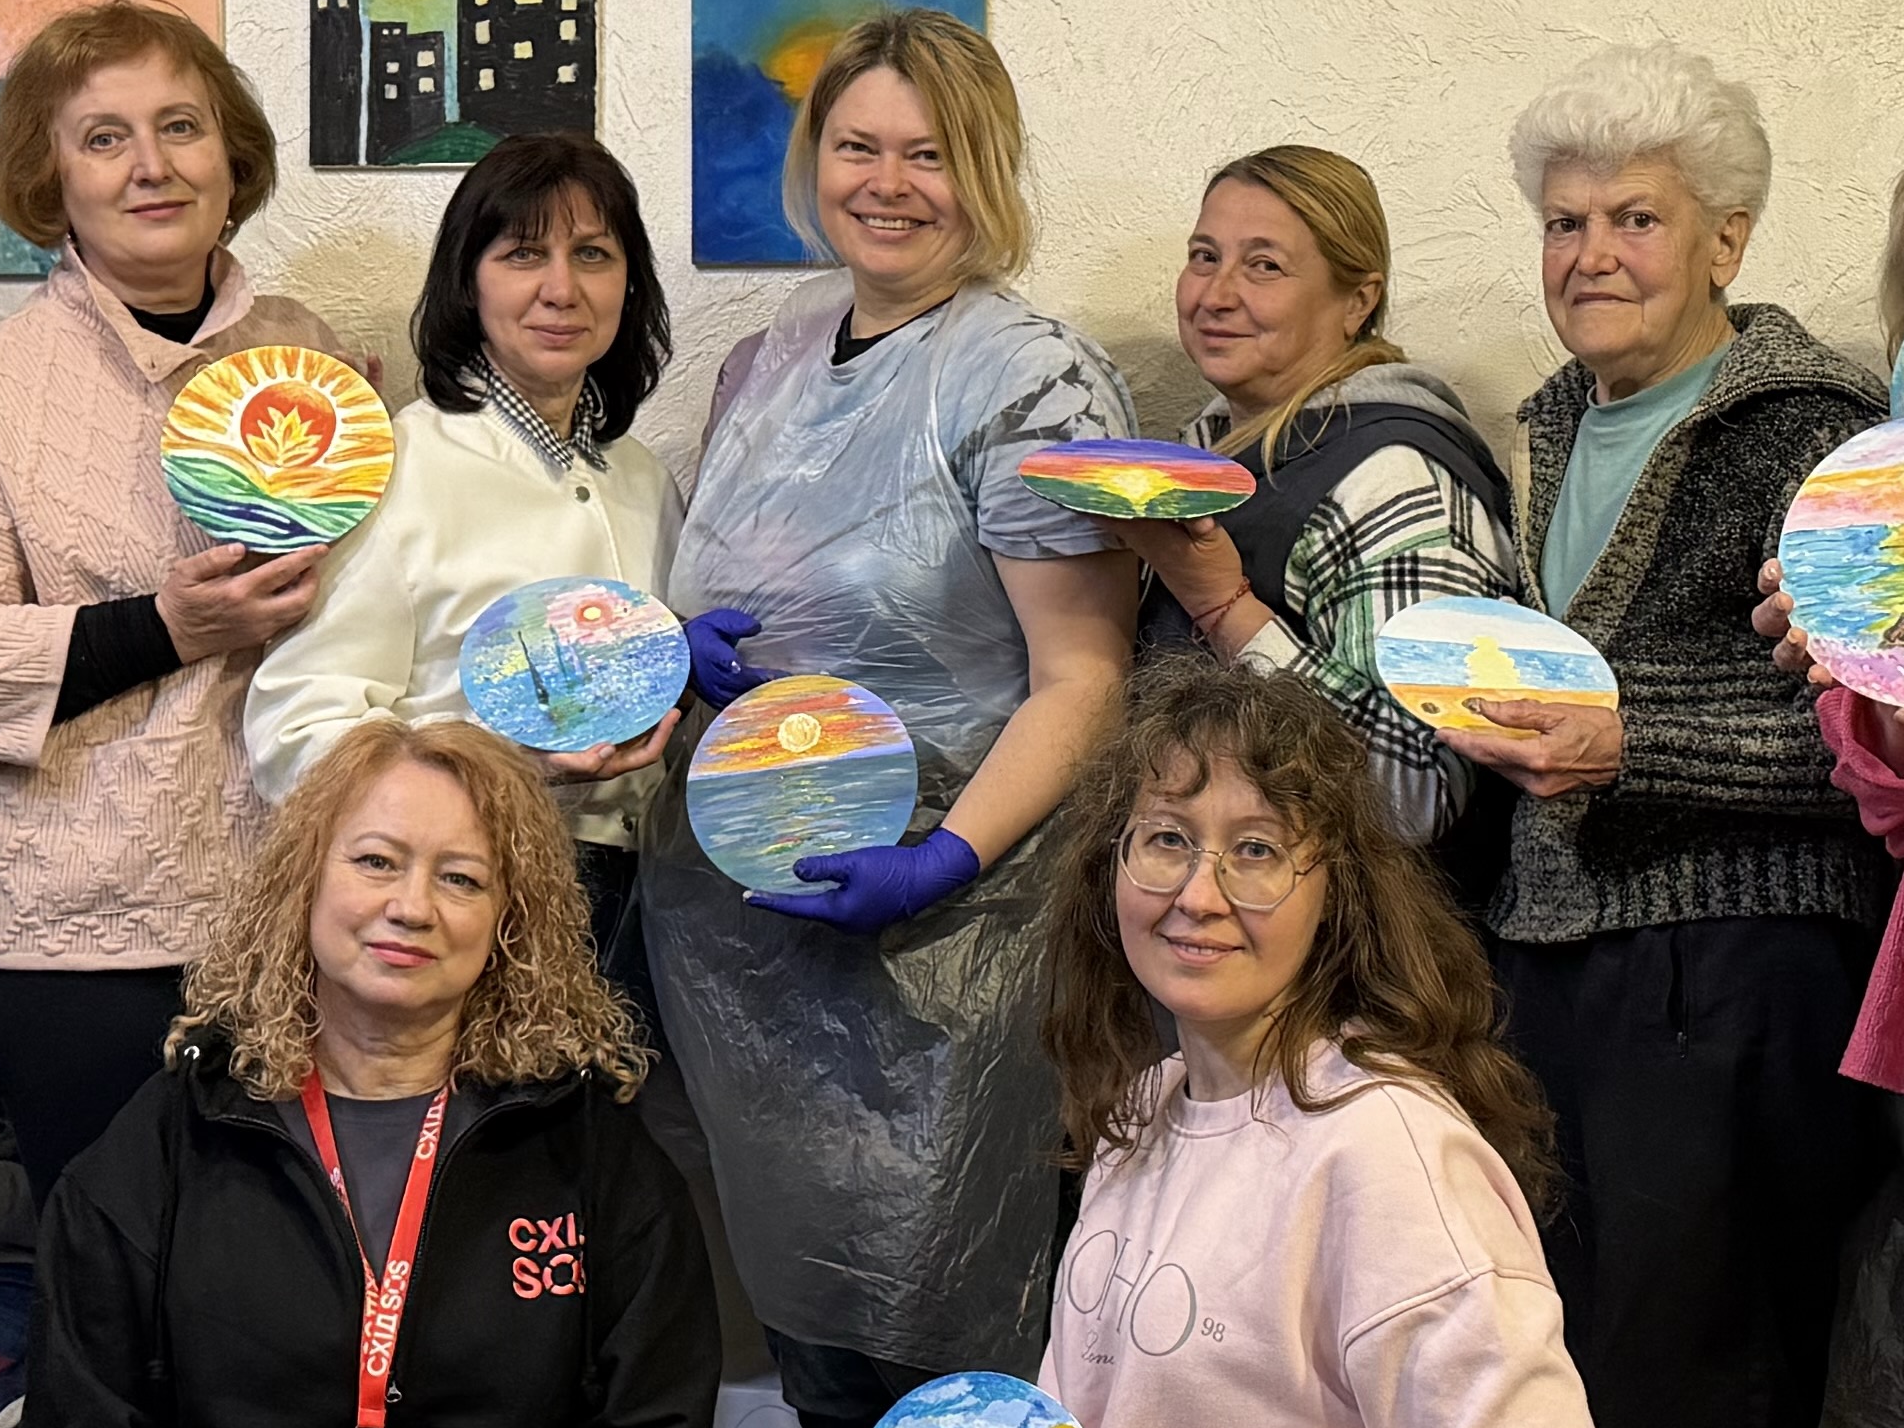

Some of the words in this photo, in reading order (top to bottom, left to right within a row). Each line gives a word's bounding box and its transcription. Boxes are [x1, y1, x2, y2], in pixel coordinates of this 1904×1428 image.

[508, 1212, 585, 1253] СХІ
[380, 1259, 409, 1310] SOS
[512, 1253, 586, 1299] SO
[367, 1313, 398, 1376] СХІД
[1201, 1317, 1226, 1343] 98
